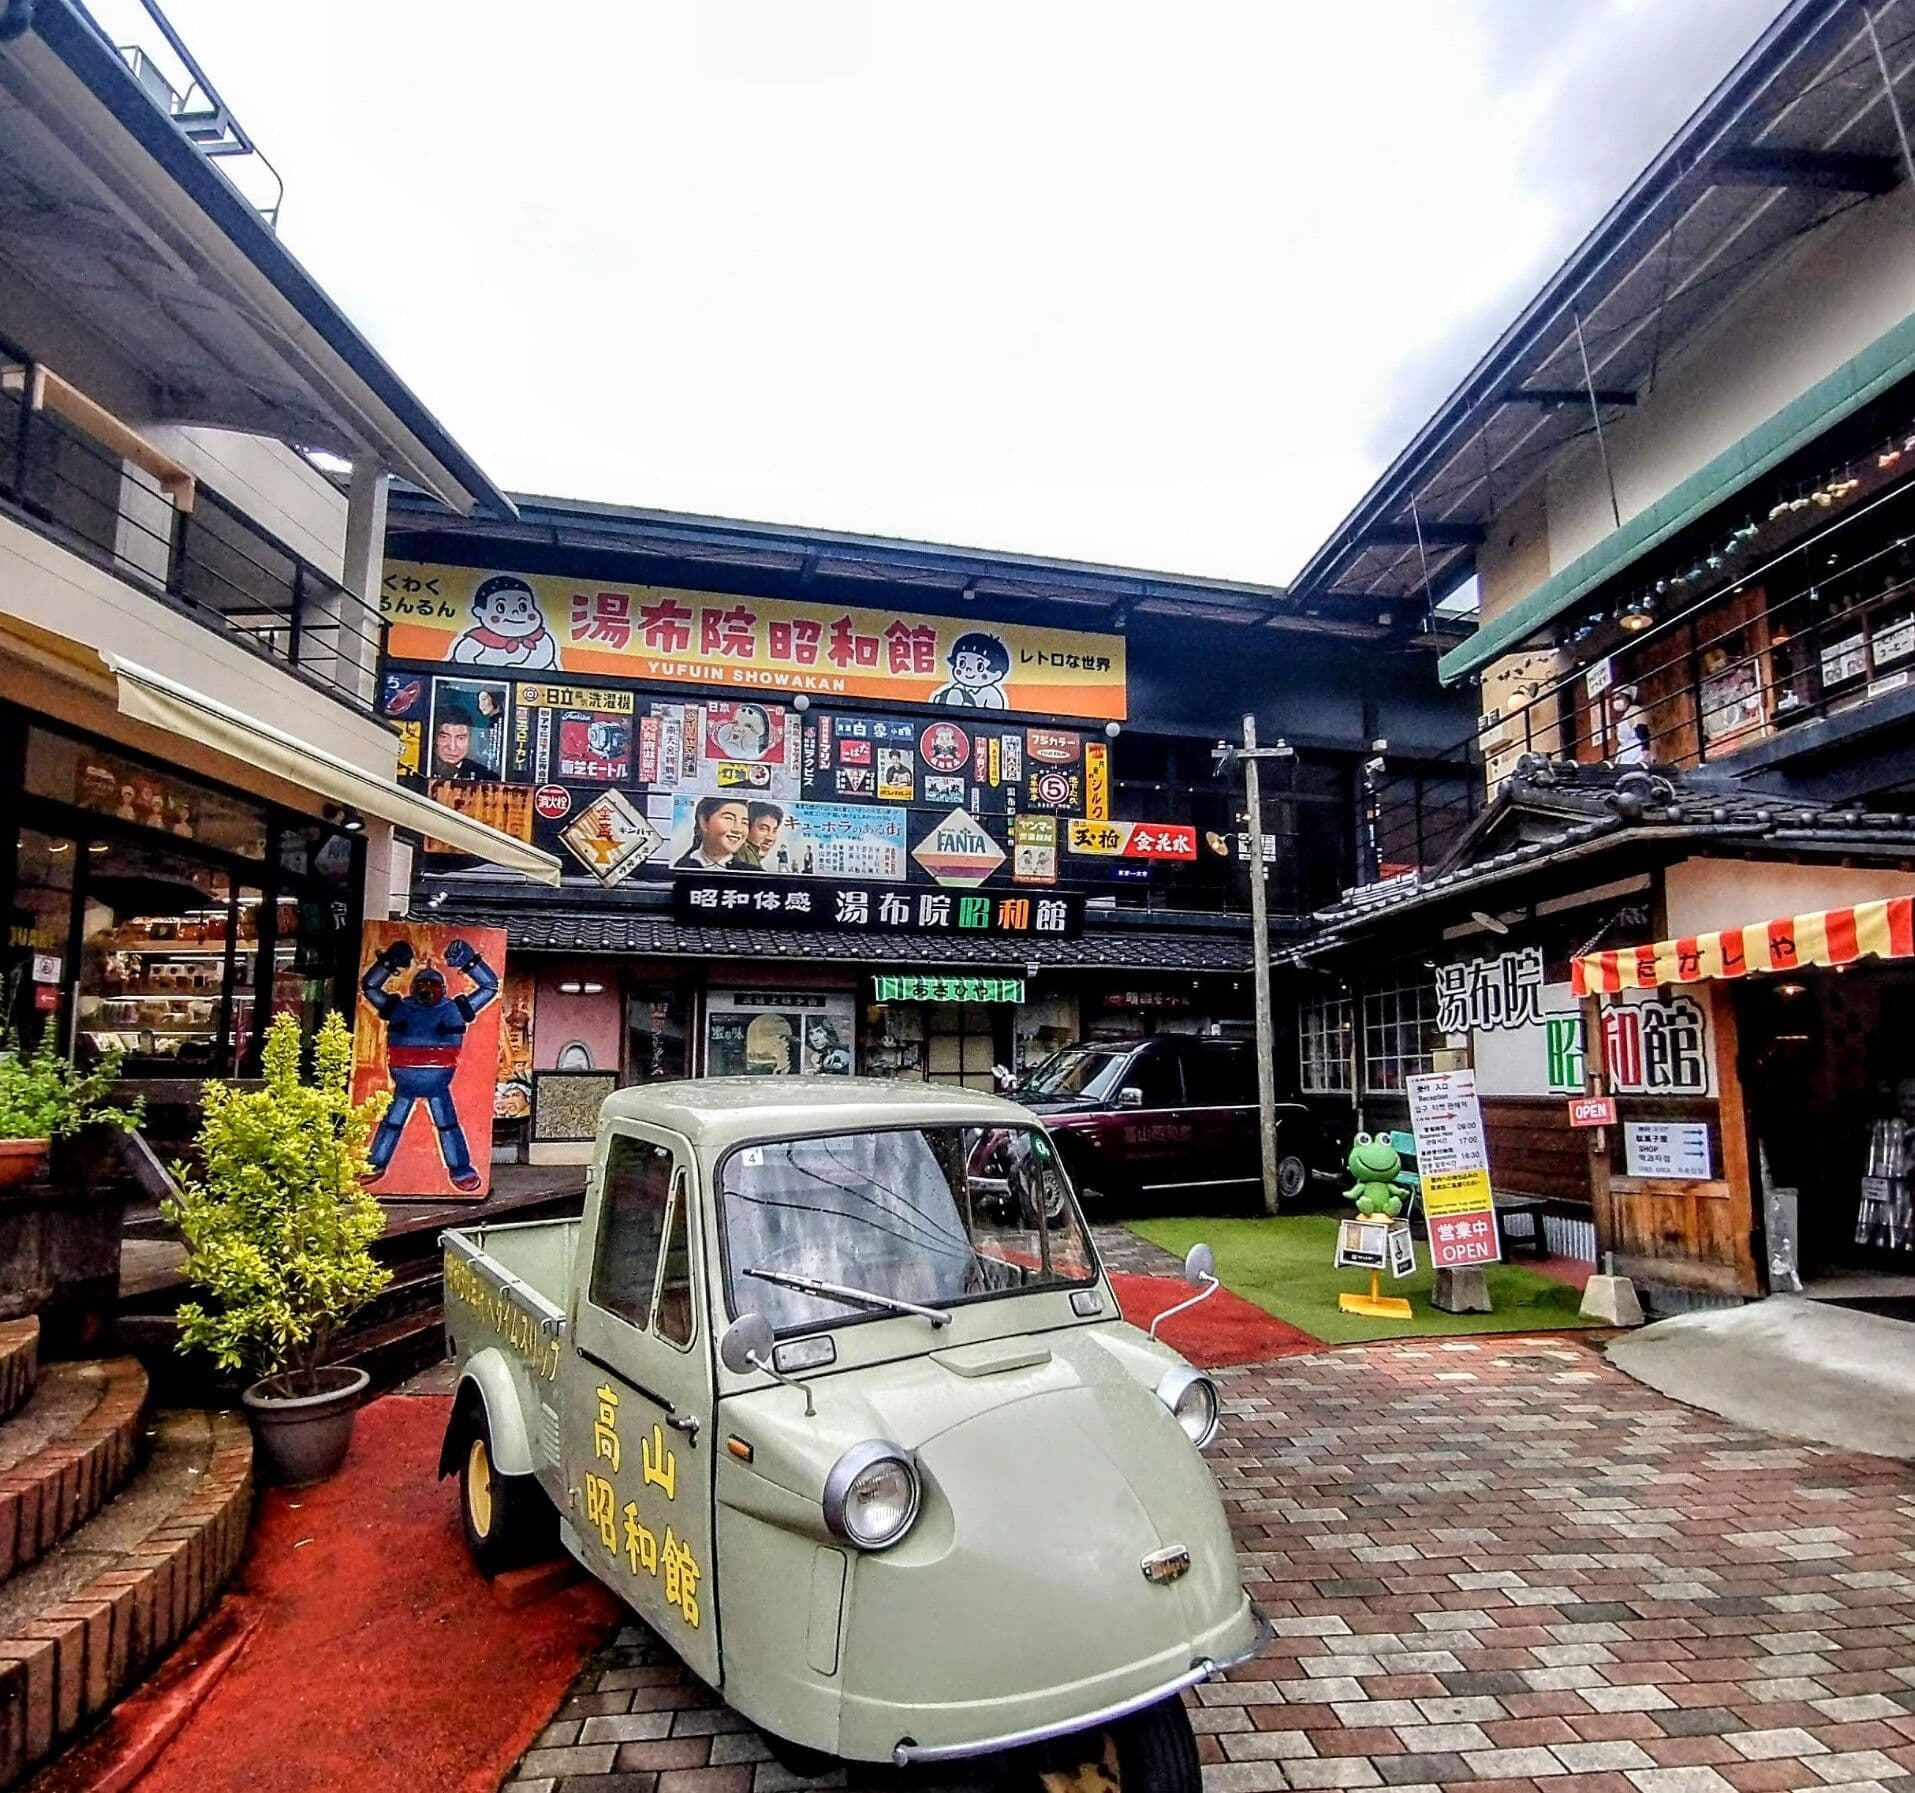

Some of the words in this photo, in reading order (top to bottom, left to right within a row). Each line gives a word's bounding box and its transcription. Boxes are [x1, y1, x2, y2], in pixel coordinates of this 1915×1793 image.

[571, 592, 938, 676] 湯布院昭和館
[1019, 648, 1111, 674] レトロな世界
[647, 660, 726, 682] YUFUIN
[733, 668, 846, 692] SHOWAKAN
[1031, 735, 1076, 748] フジカラー
[561, 758, 628, 779] 東芝モートル
[538, 796, 568, 810] 消火栓
[1018, 820, 1054, 833] ヤンマー
[936, 830, 987, 854] FANTA
[689, 888, 812, 913] 昭和体感
[835, 890, 1068, 932] 湯布院昭和館
[1637, 936, 1797, 978] だがしや
[912, 982, 990, 998] あさひや
[1436, 950, 1542, 1031] 湯布院
[1546, 1000, 1704, 1090] 昭和館
[1417, 1093, 1449, 1102] Reception
[1434, 1083, 1449, 1091] 入口
[1575, 1102, 1608, 1120] OPEN
[1458, 1136, 1478, 1145] 17:00
[1638, 1144, 1660, 1153] SHOP
[1437, 1219, 1489, 1242] 営業中
[1442, 1242, 1489, 1262] OPEN
[593, 1382, 677, 1502] 高山
[584, 1470, 703, 1630] 昭和館
